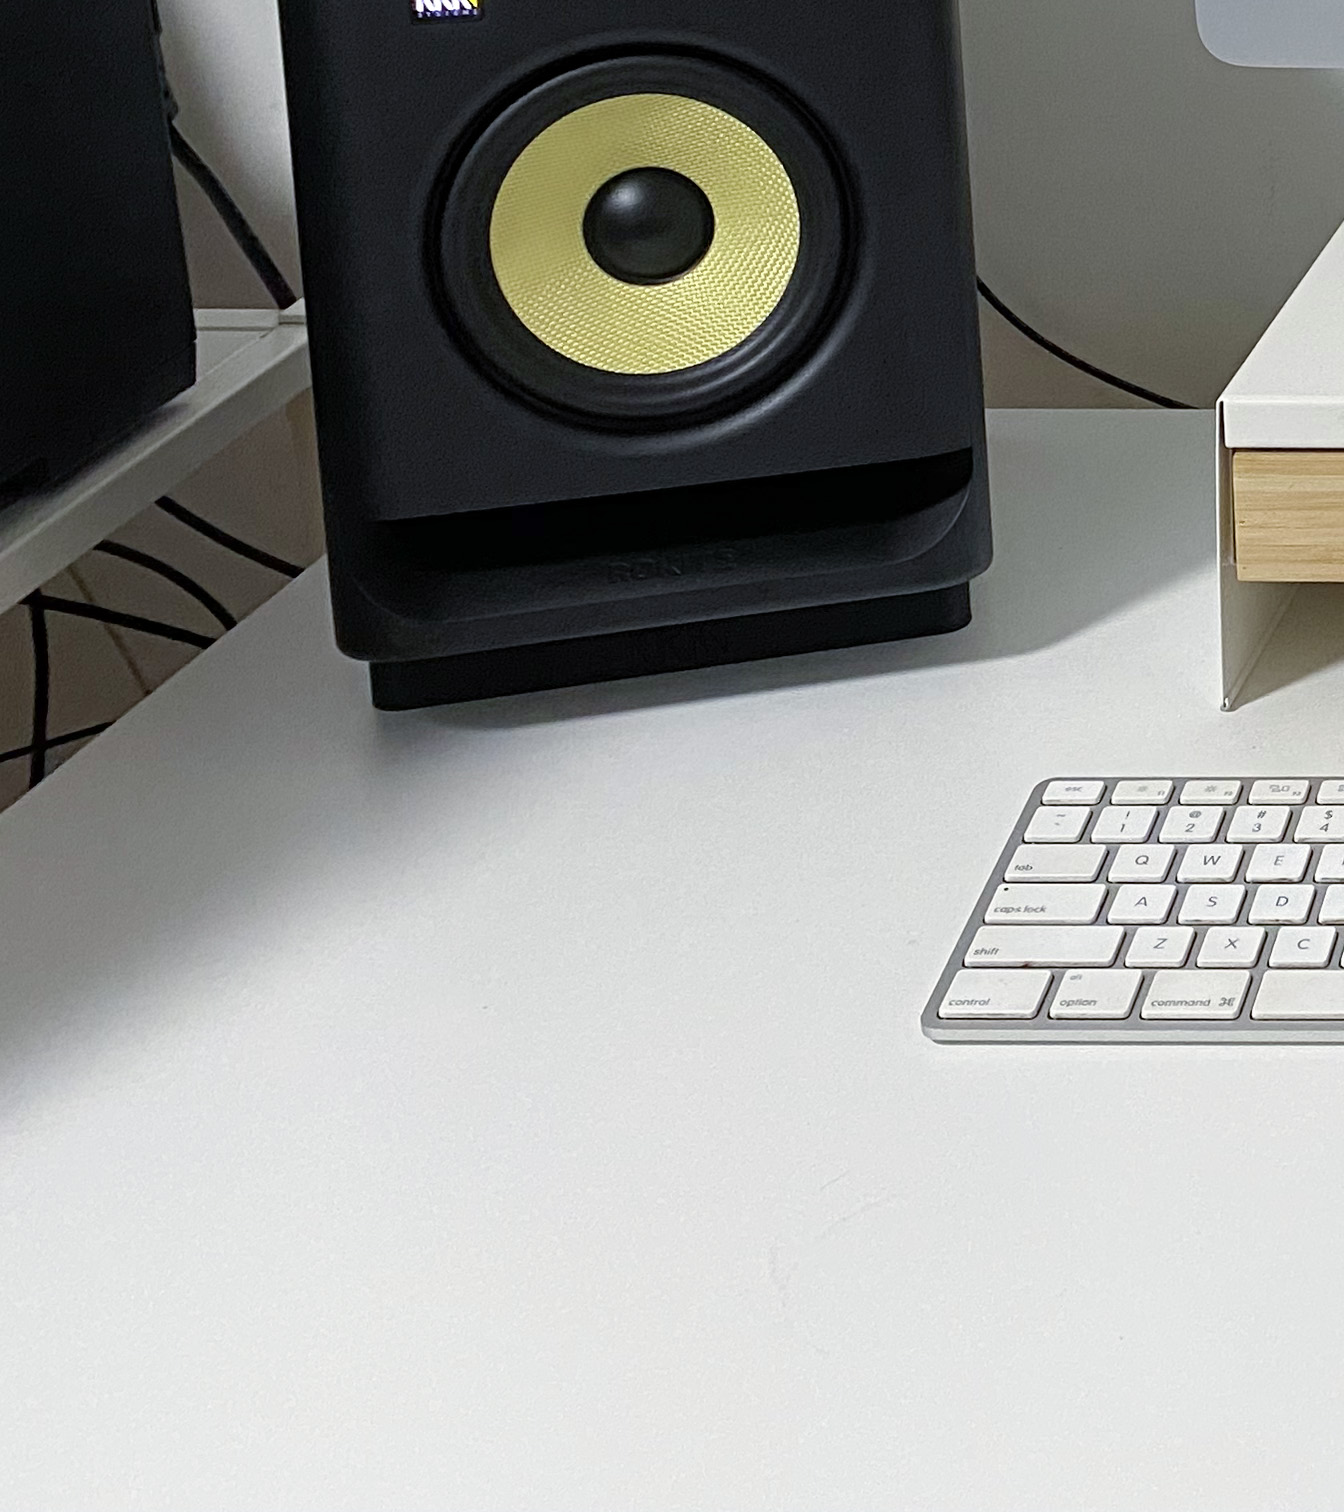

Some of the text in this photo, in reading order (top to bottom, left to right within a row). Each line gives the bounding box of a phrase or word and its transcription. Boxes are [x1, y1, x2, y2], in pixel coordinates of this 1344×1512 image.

[1135, 855, 1149, 865] Q
[1204, 856, 1221, 865] W
[1014, 863, 1033, 872] tab
[1135, 897, 1147, 906] A
[1276, 896, 1288, 906] D
[993, 904, 1019, 915] caps
[973, 946, 999, 956] shift
[948, 997, 990, 1006] control
[1059, 997, 1097, 1008] option
[1151, 997, 1211, 1007] command
